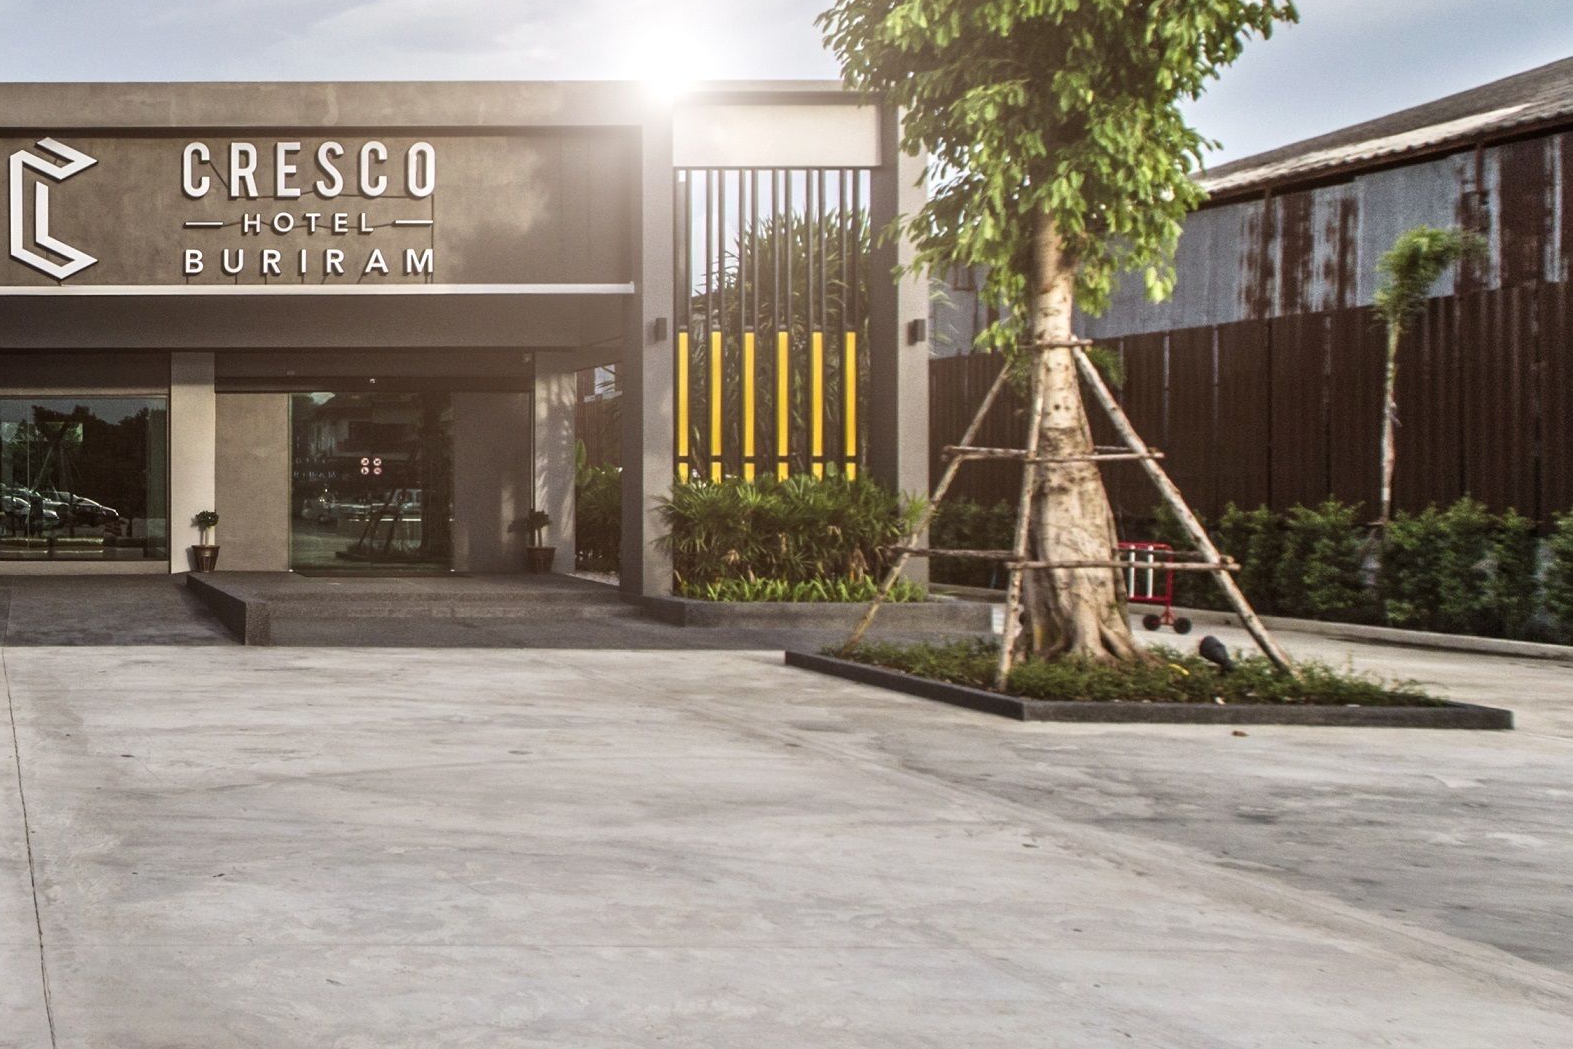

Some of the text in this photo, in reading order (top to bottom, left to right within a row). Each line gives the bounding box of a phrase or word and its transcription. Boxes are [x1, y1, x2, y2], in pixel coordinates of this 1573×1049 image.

[182, 141, 436, 198] CRESCO
[244, 212, 374, 233] HOTEL
[185, 248, 434, 274] BURIRAM
